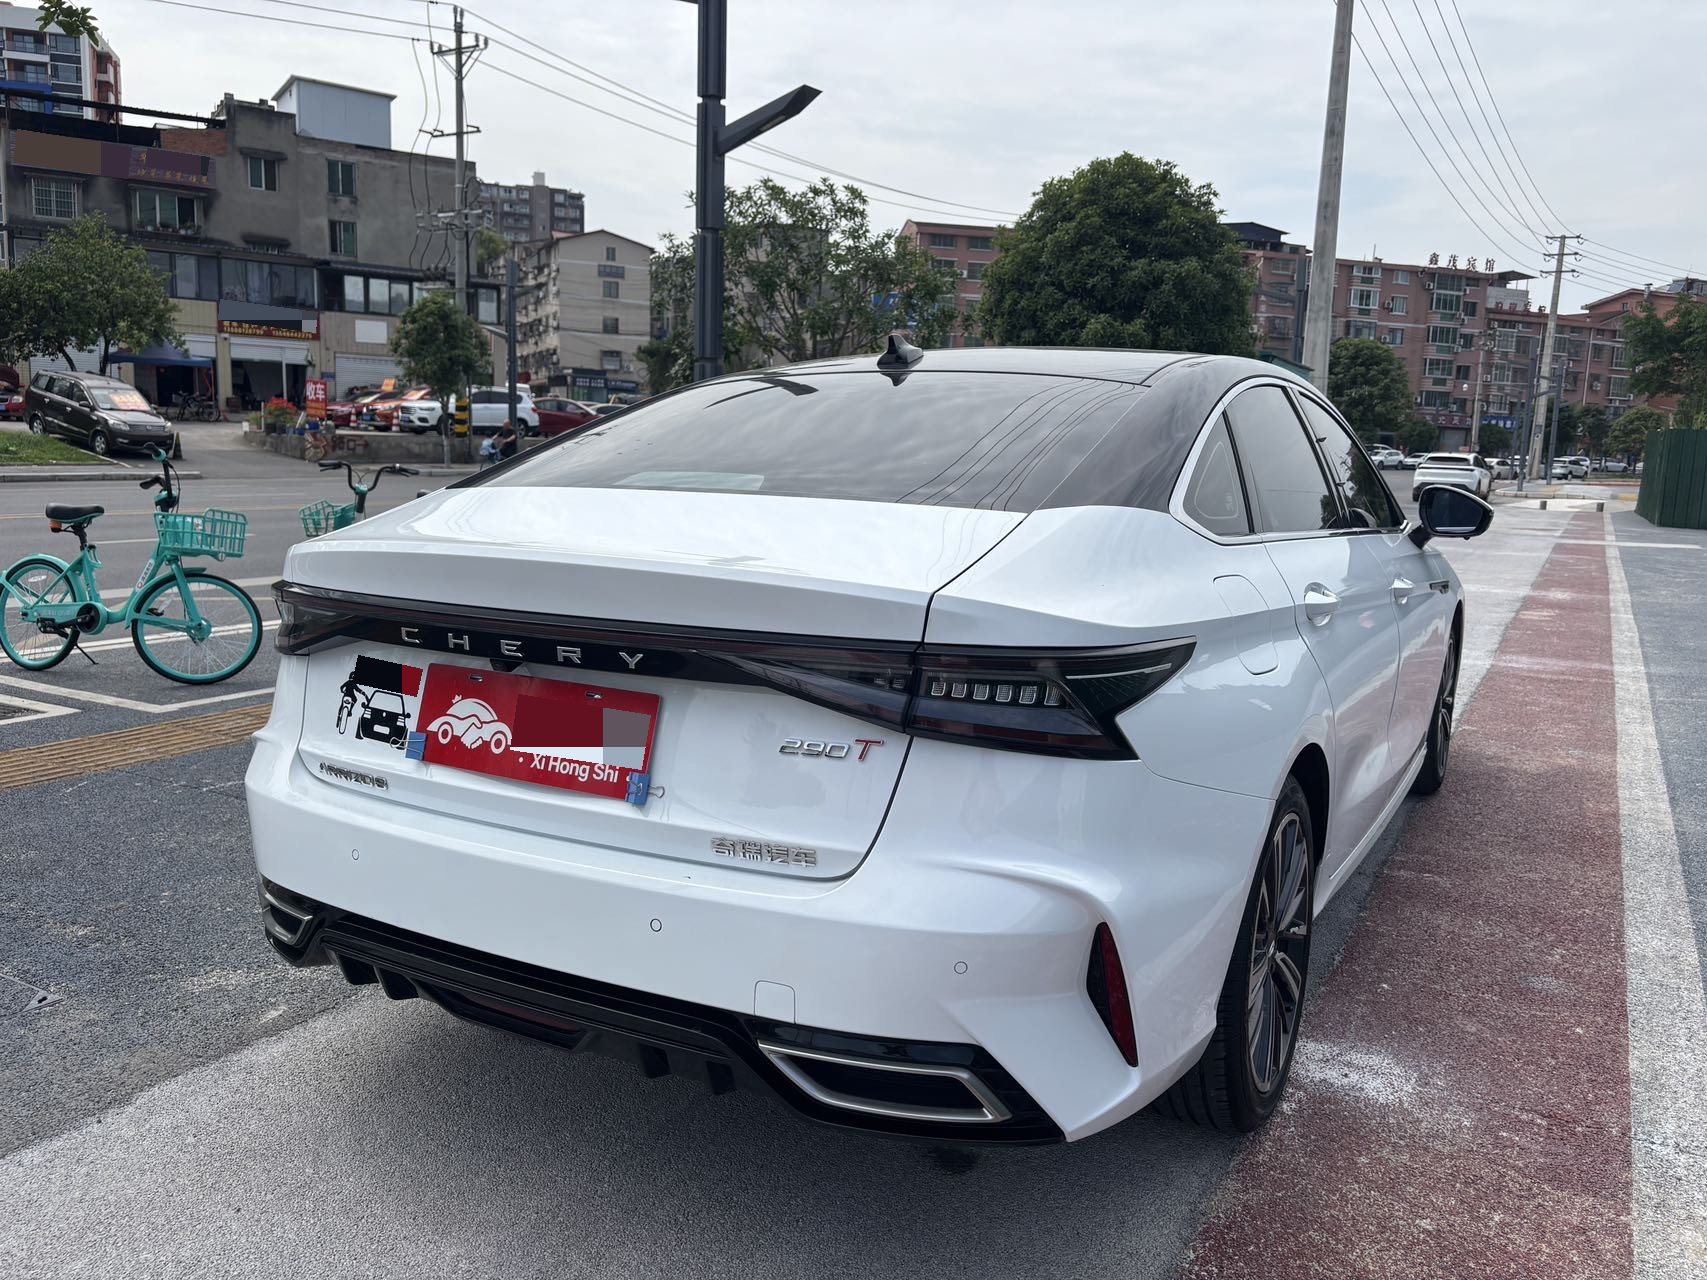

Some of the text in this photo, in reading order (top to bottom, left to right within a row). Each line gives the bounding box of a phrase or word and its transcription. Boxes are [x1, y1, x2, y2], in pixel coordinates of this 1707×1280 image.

[1428, 252, 1496, 272] 鑫茂宾馆
[306, 382, 325, 401] 收车
[401, 627, 643, 669] CHERY
[530, 754, 620, 783] Xi Hong Shi
[711, 838, 817, 867] 奇瑞汽车
